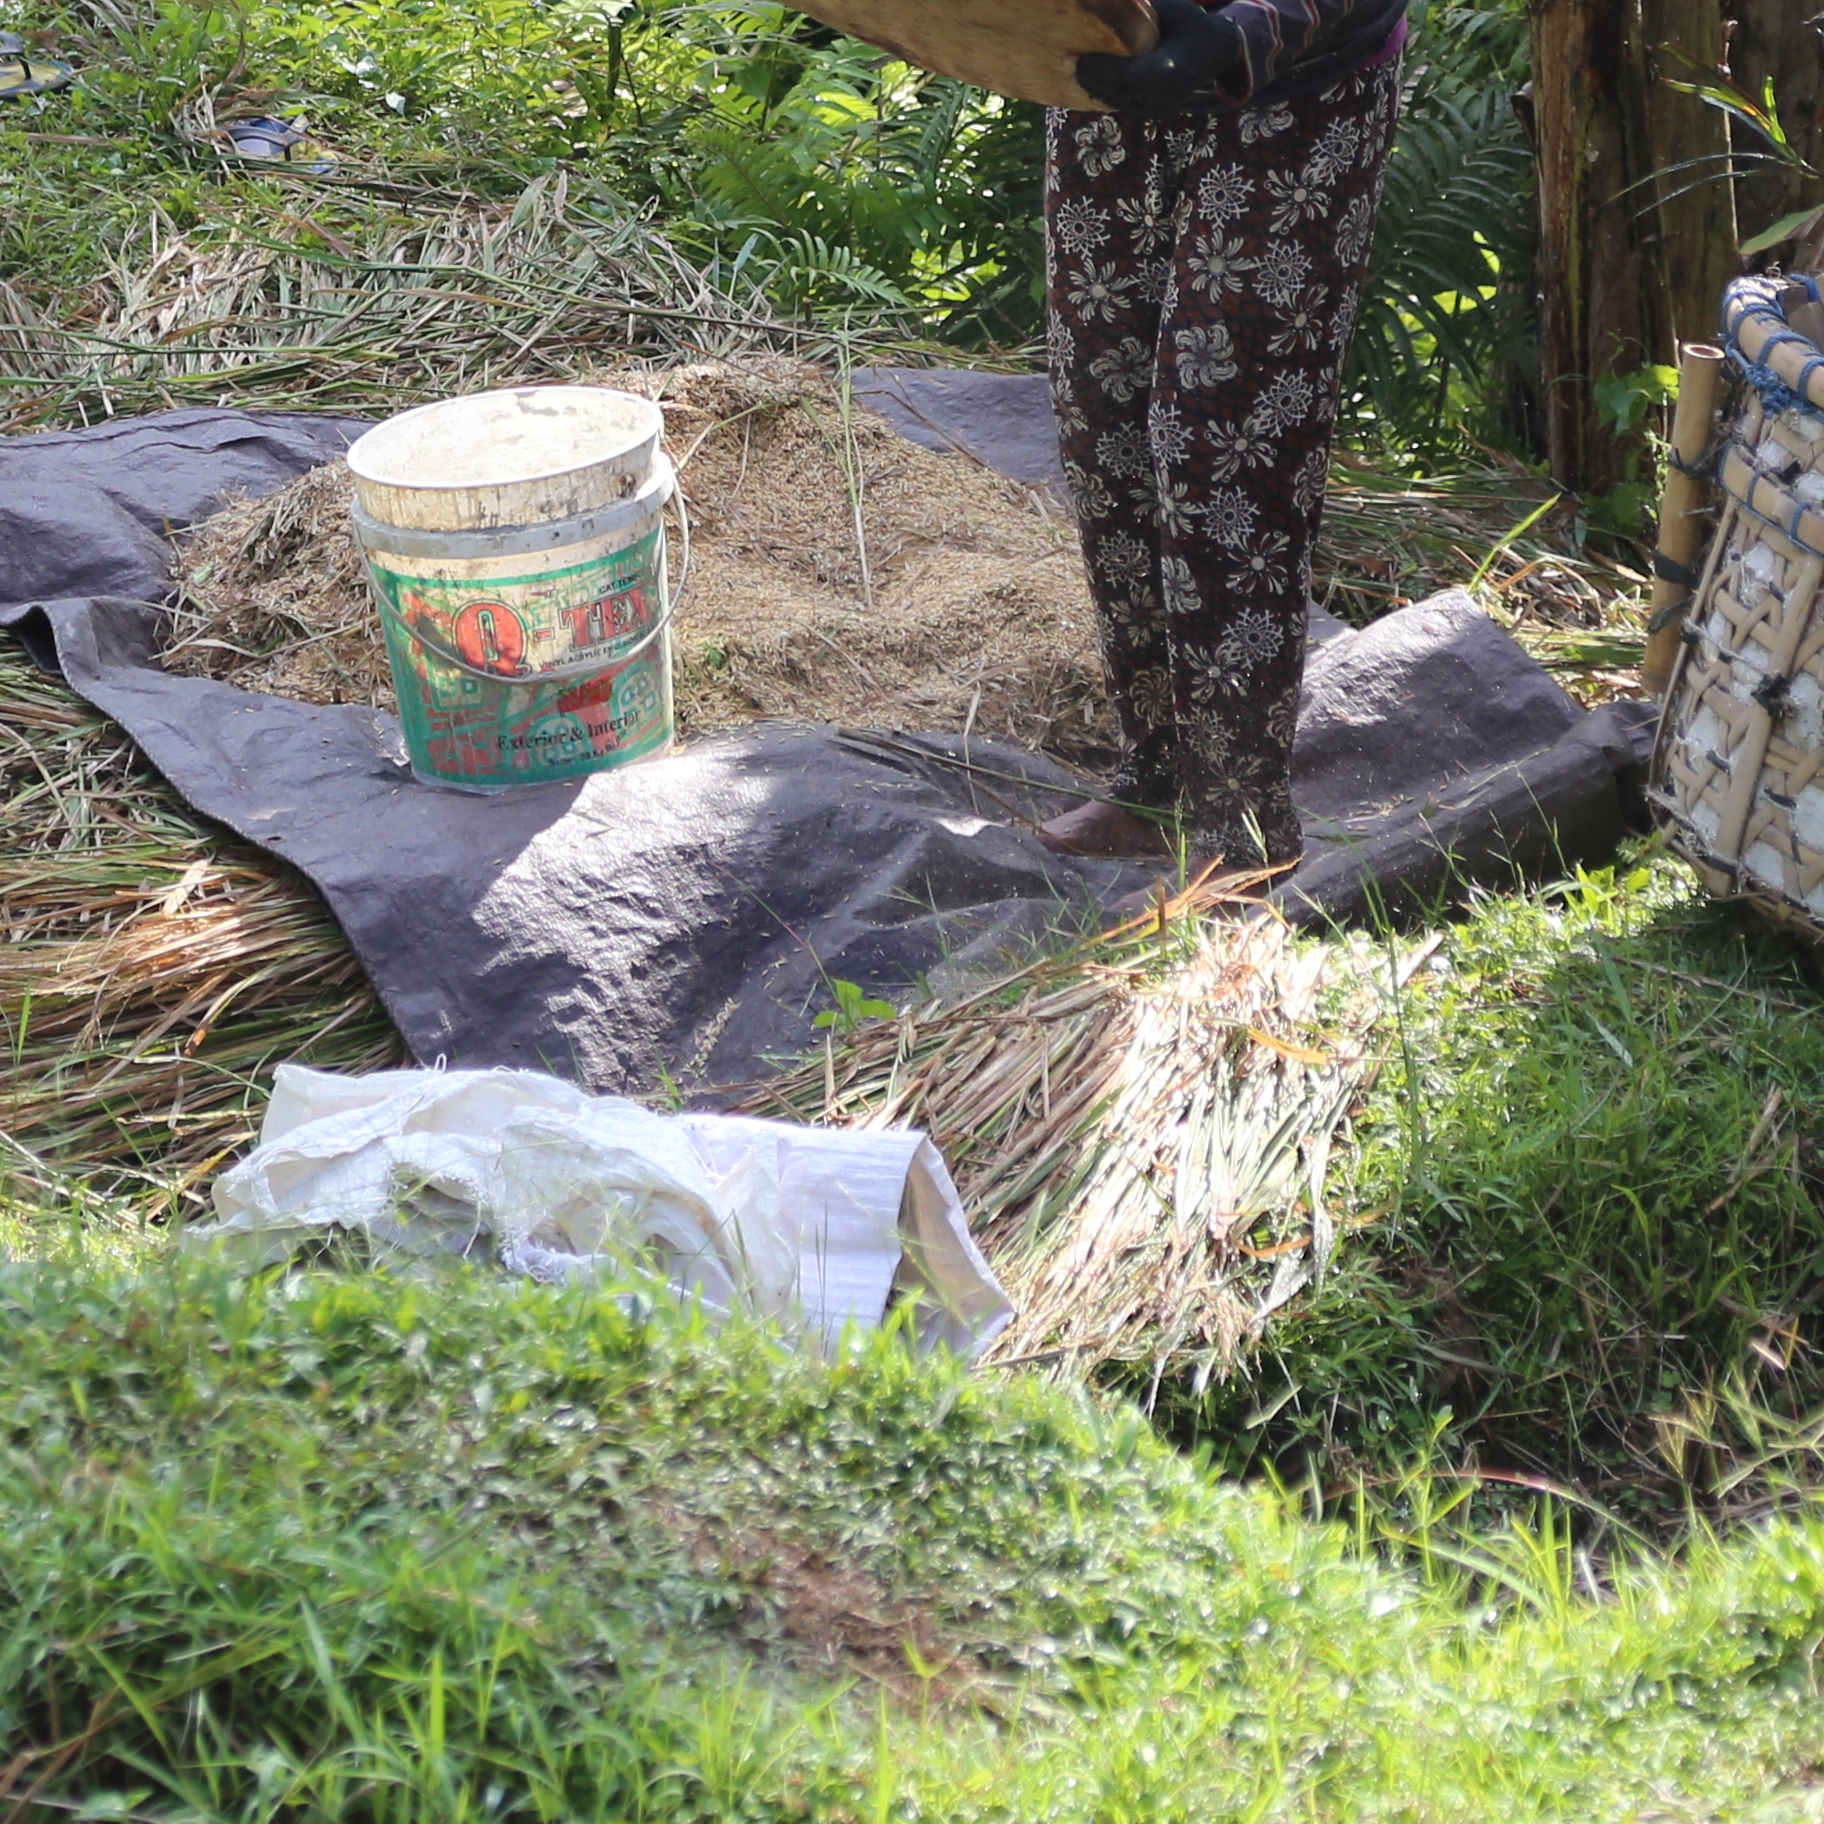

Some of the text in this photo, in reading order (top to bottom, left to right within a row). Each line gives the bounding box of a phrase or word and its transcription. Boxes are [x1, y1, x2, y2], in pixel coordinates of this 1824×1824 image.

[568, 650, 602, 664] ACRYLIC
[498, 711, 640, 751] Exterior & Interior
